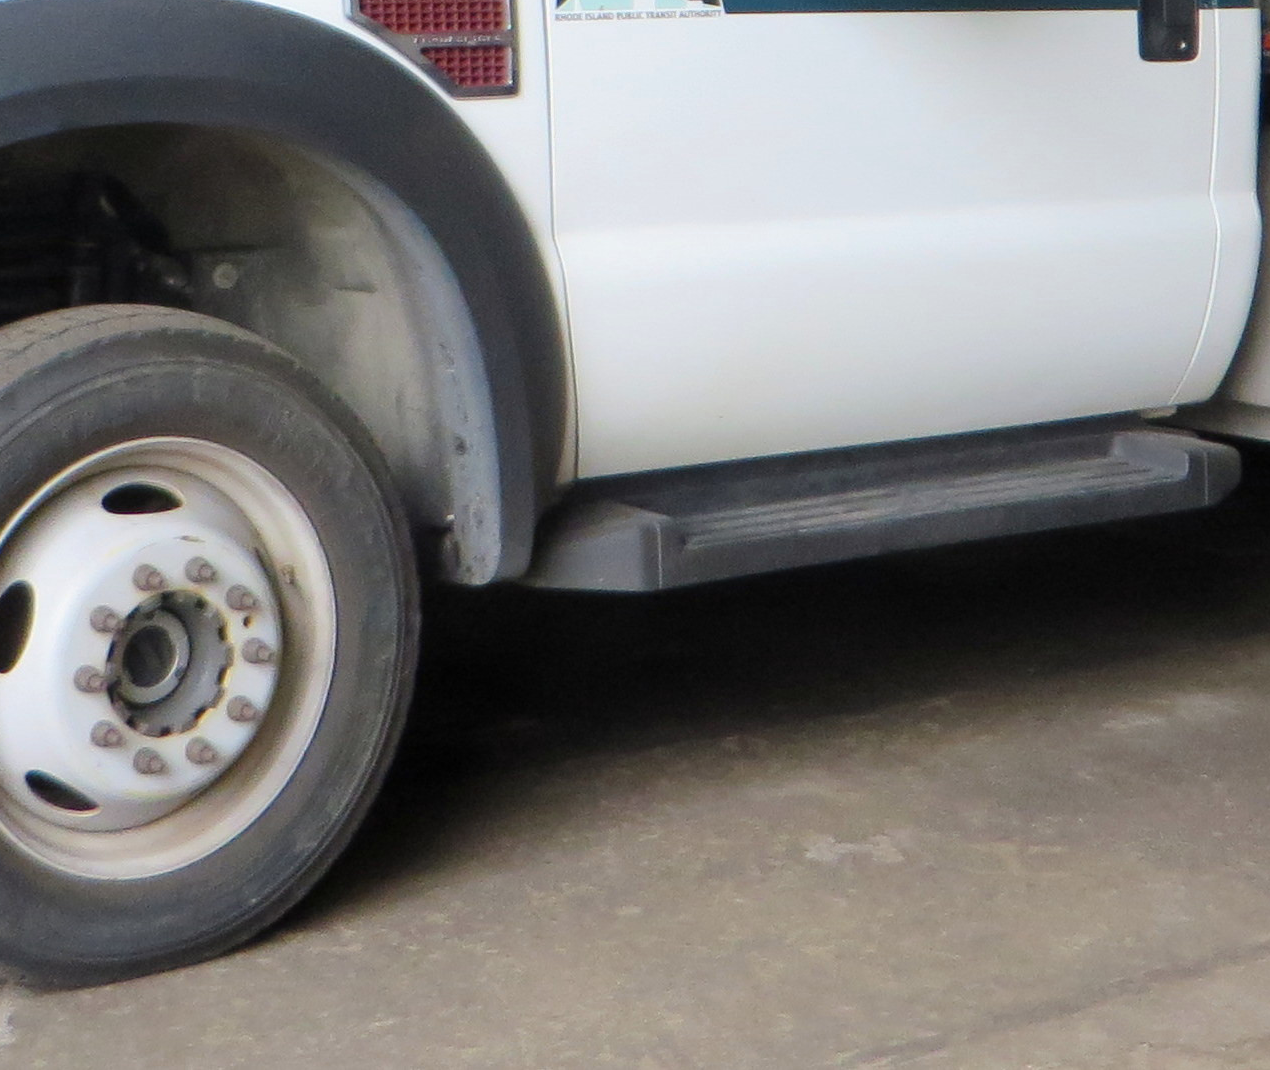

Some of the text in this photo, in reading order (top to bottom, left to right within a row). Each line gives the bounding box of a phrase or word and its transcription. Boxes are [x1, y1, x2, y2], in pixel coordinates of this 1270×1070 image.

[555, 10, 722, 21] RHODE ISLAND PUBLIC TRANSIT AUTHORITY
